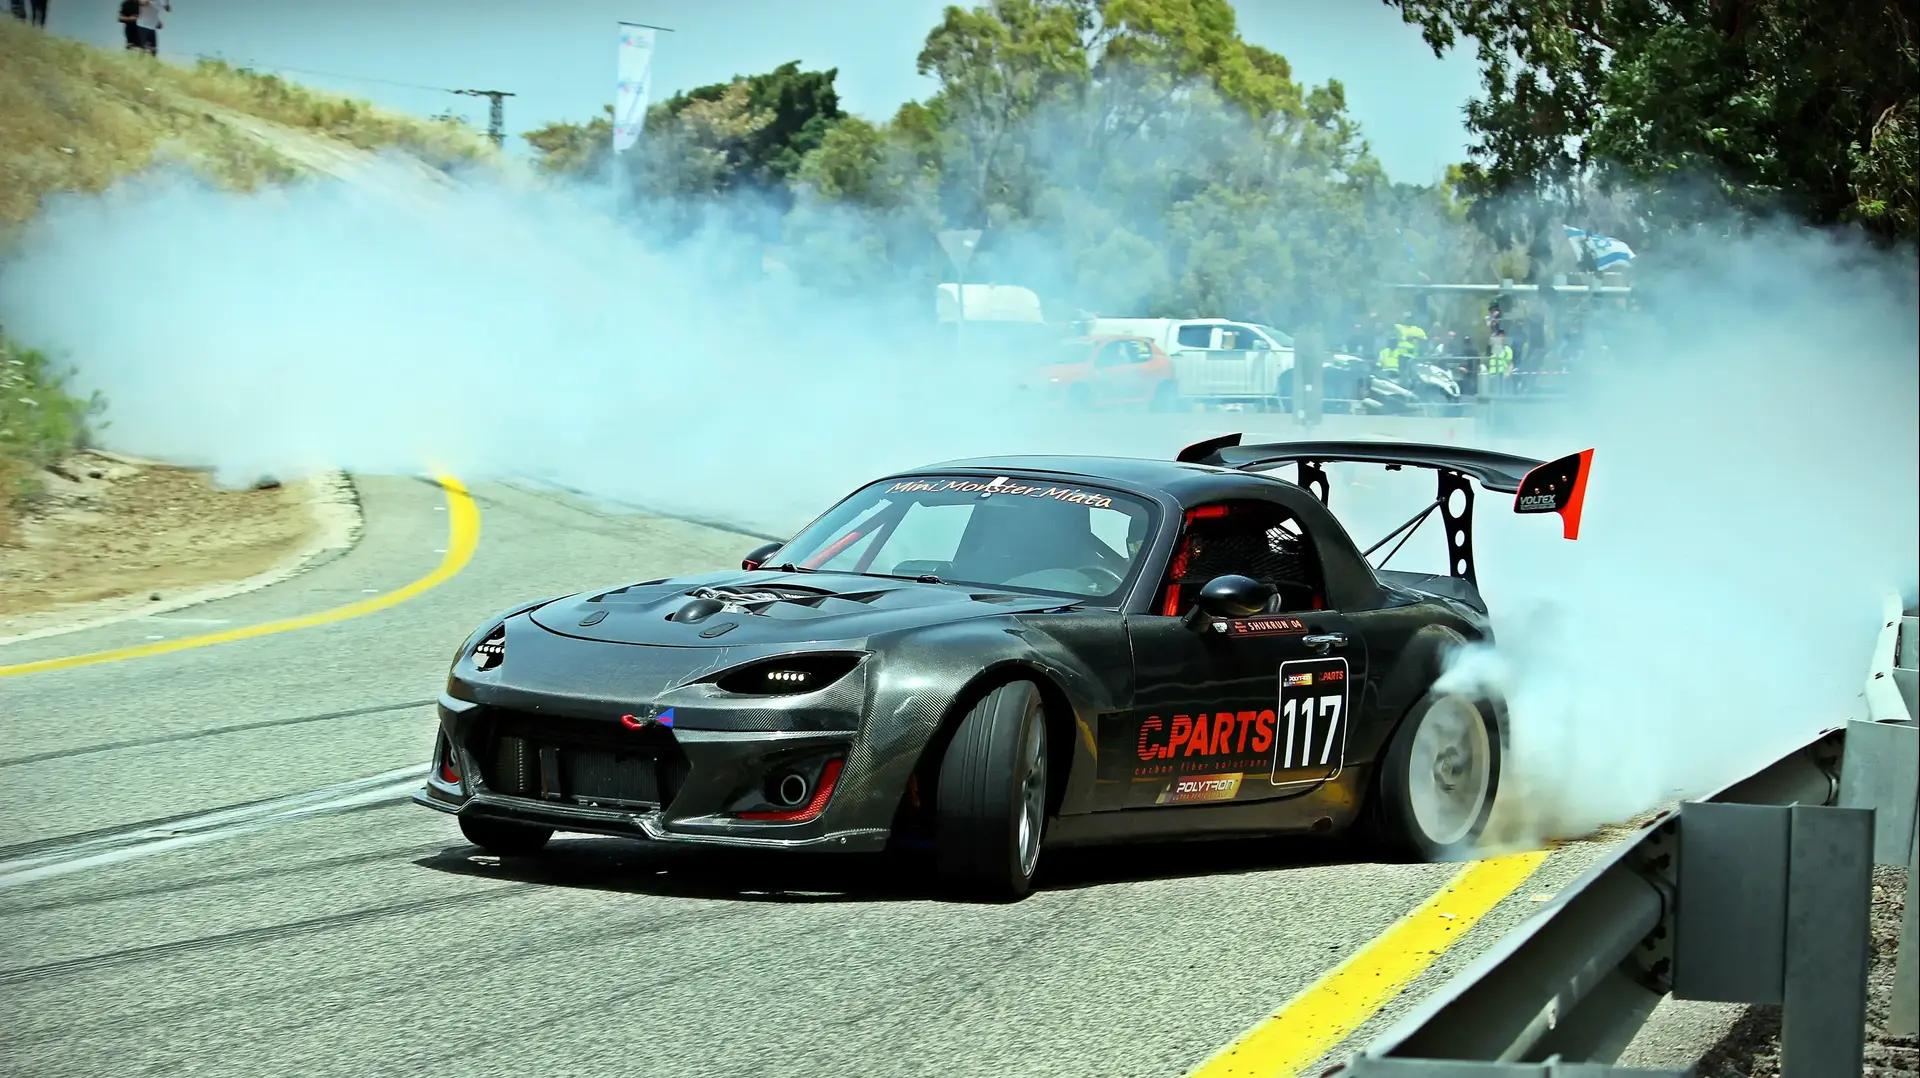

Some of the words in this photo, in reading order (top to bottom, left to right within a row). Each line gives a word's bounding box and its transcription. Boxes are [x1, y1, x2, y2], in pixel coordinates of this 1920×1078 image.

[1520, 494, 1556, 505] VOLTEX
[1247, 620, 1289, 631] SHUKRUN
[1290, 619, 1302, 629] 04
[1137, 709, 1275, 760] C.PARTS
[1283, 694, 1342, 769] 117
[1134, 764, 1174, 775] carbon
[1180, 760, 1209, 772] fiber
[1176, 779, 1235, 793] POLYTRON
